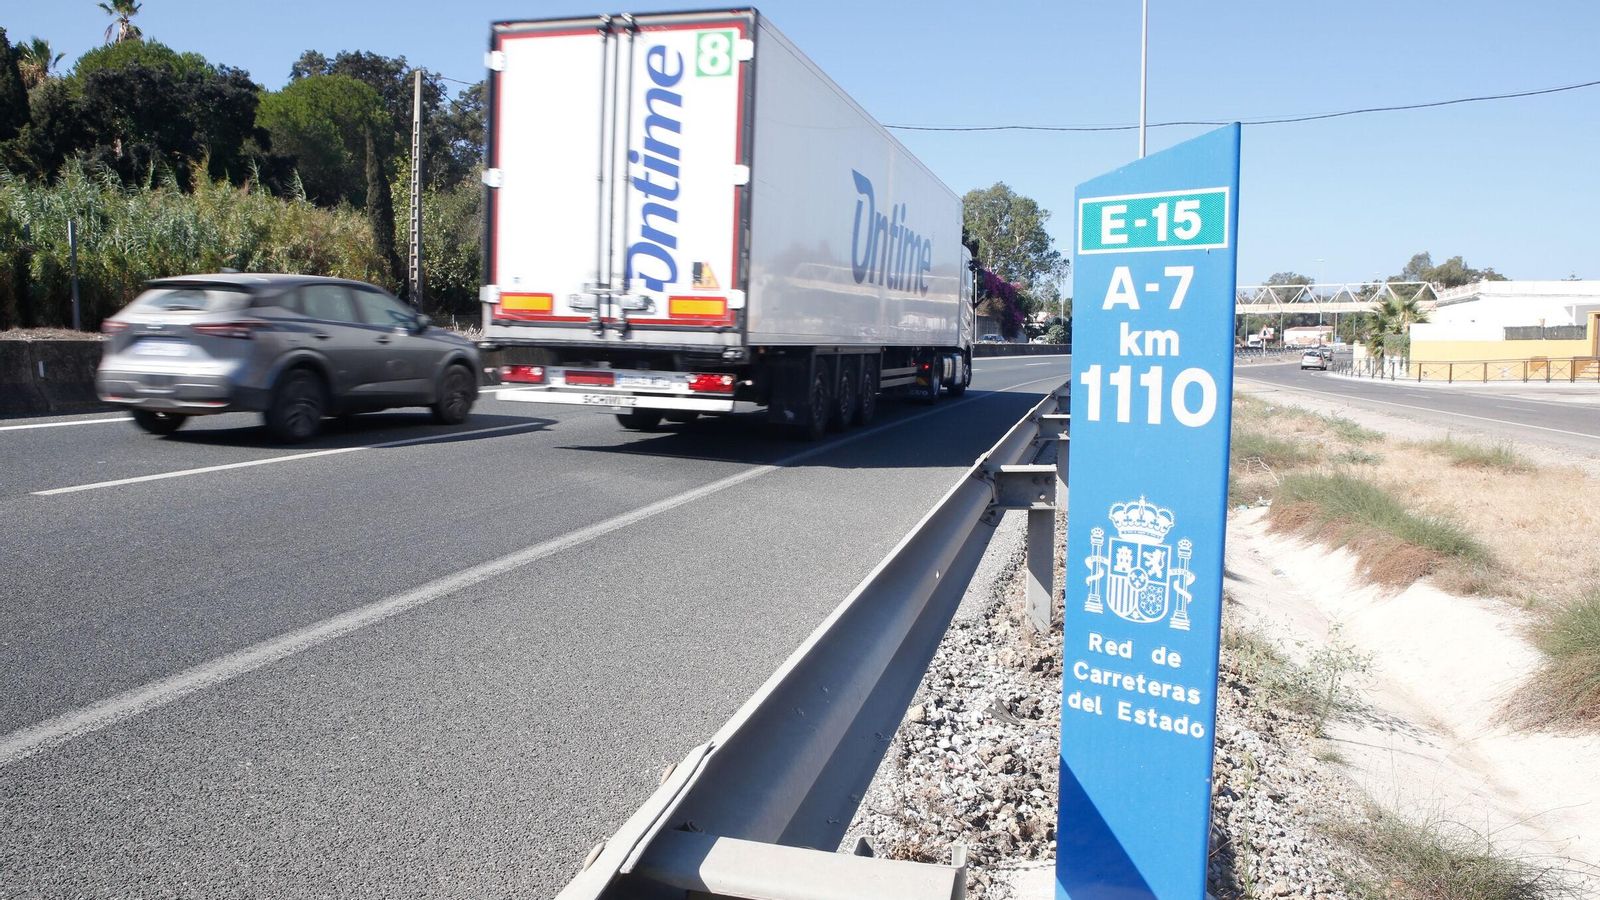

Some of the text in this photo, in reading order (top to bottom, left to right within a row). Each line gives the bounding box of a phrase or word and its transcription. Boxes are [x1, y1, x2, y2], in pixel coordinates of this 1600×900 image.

[697, 32, 731, 76] 8
[626, 45, 684, 292] Ontime
[852, 168, 931, 297] Ontime
[1101, 200, 1202, 244] E-15
[1102, 266, 1194, 310] A-7
[1119, 322, 1180, 356] km
[1080, 364, 1217, 428] 1110
[1088, 633, 1182, 668] Red de
[1073, 661, 1201, 705] Carreteras
[1067, 691, 1205, 739] del Estado
